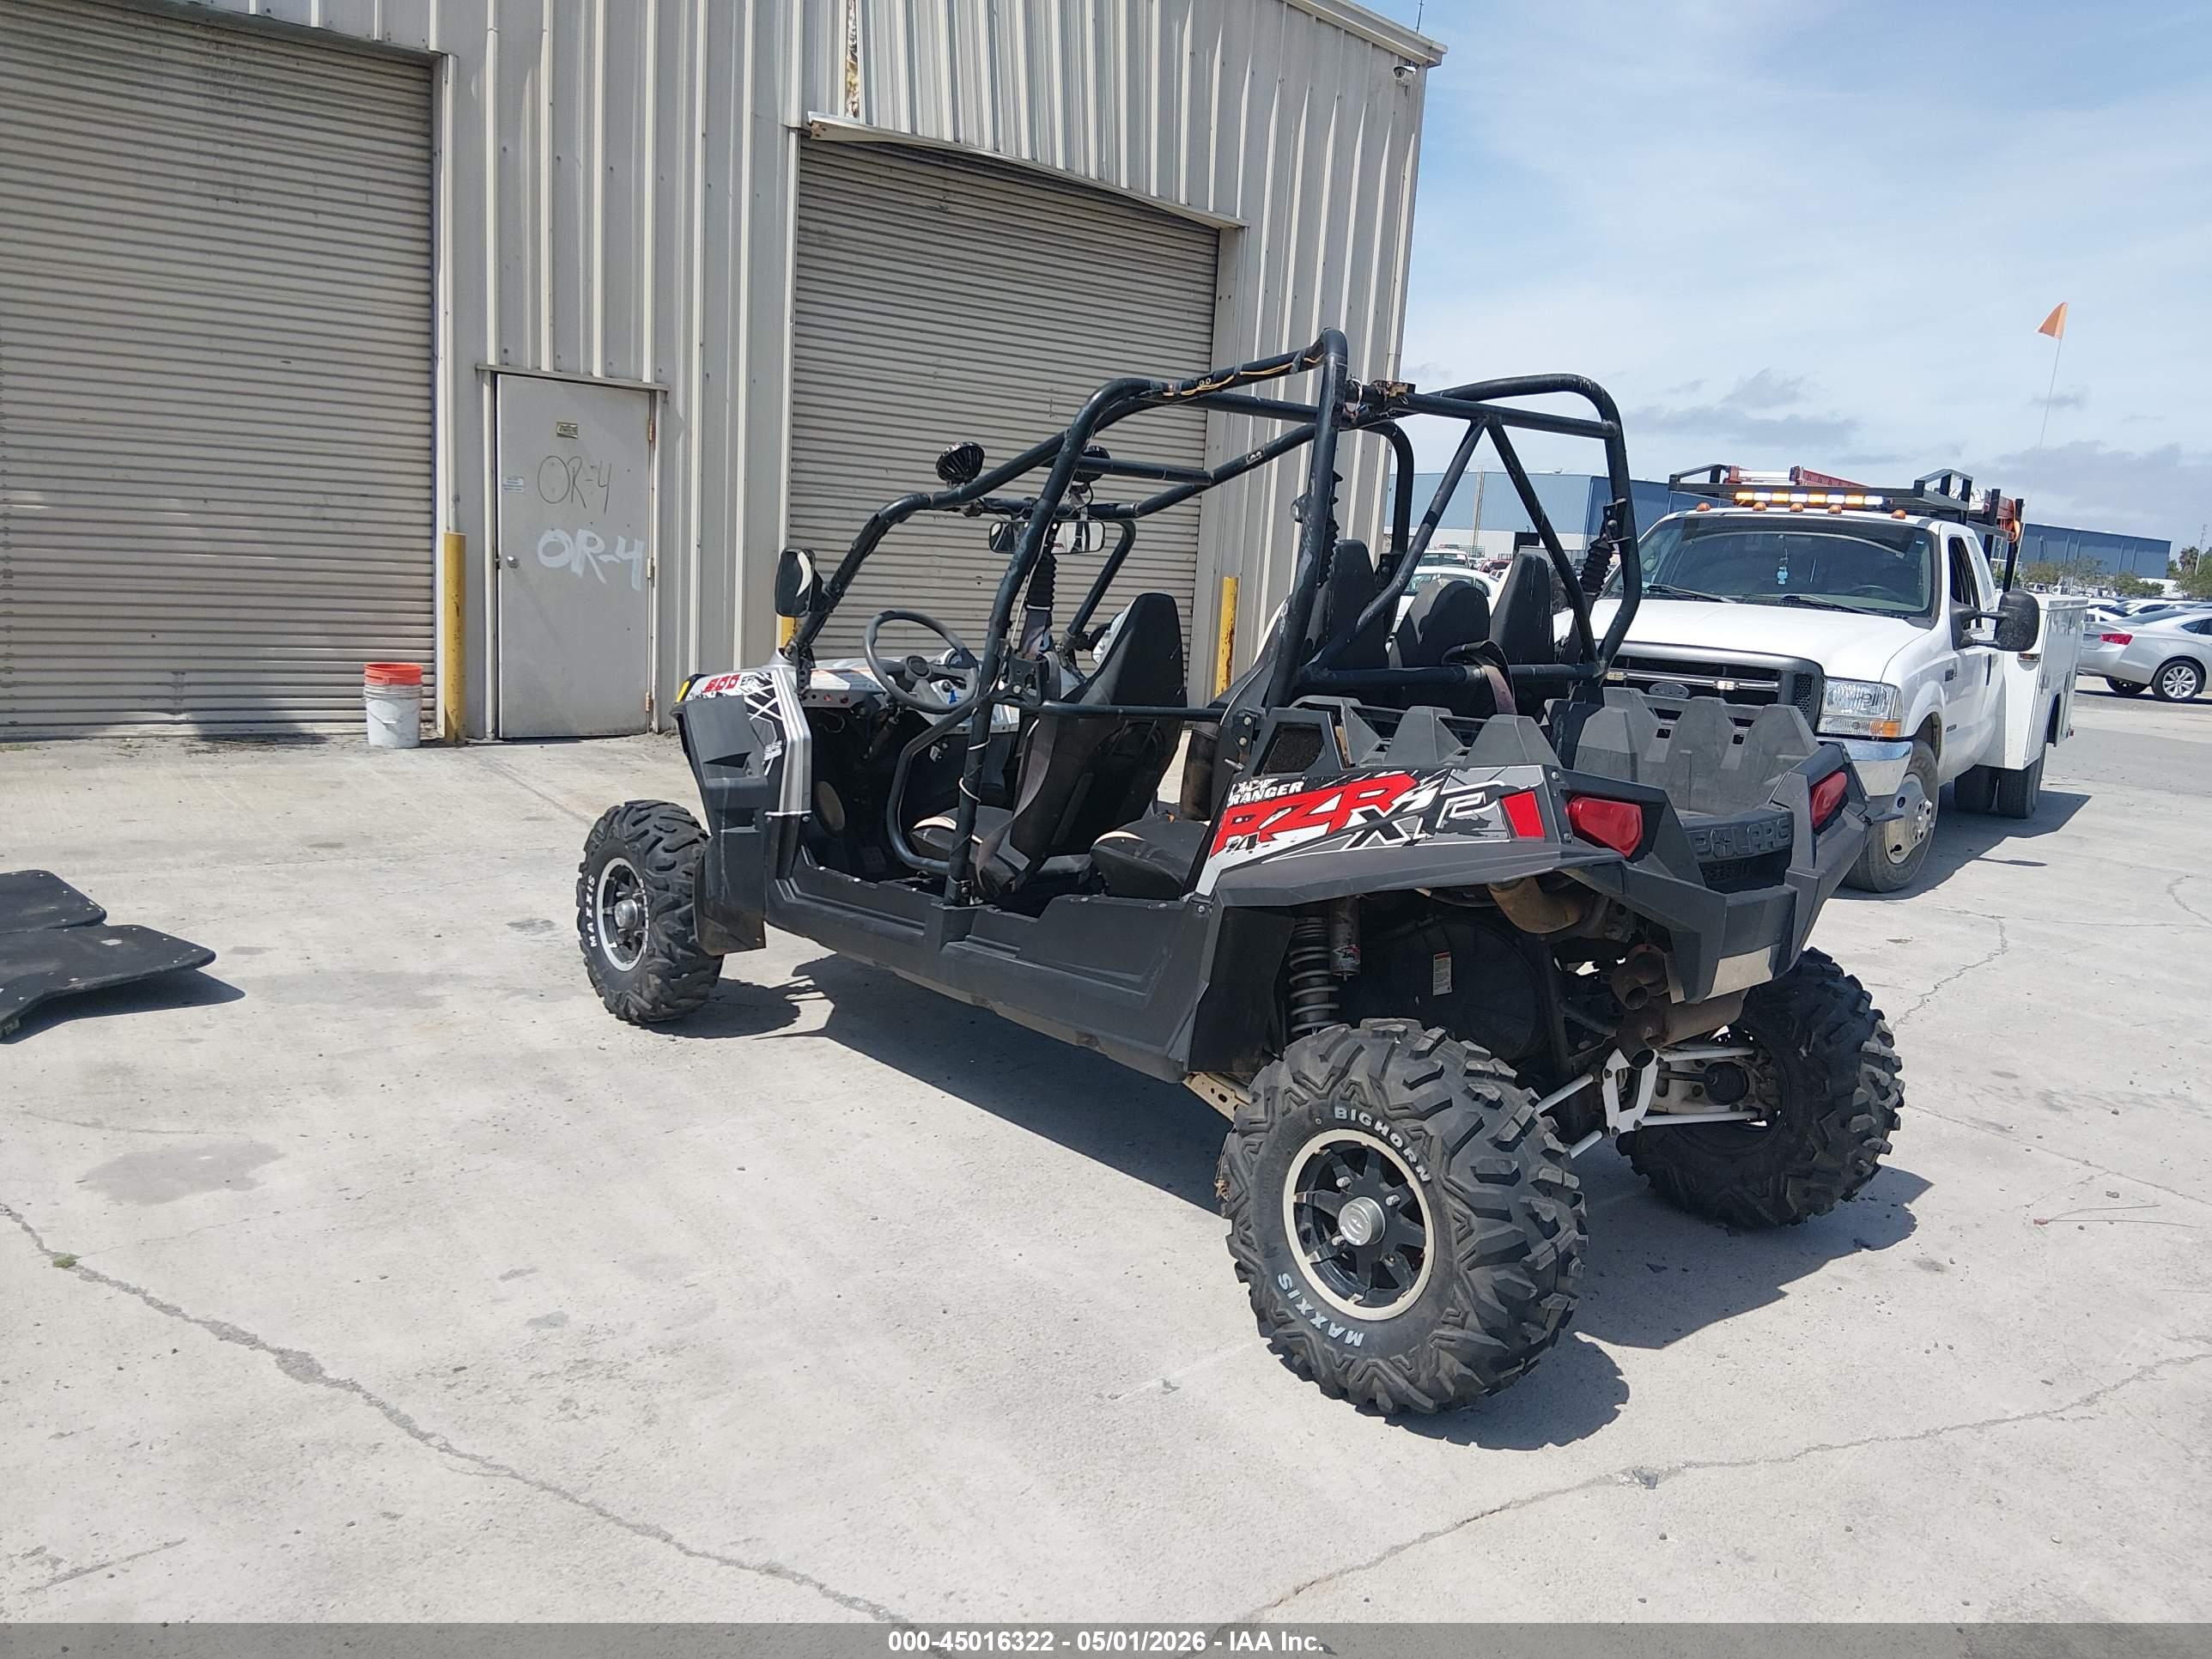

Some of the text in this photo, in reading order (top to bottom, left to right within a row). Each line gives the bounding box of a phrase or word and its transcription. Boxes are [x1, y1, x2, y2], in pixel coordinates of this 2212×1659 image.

[538, 455, 611, 515] OR-4
[538, 528, 644, 592] OR-4
[1211, 773, 1417, 856] RZR
[1226, 781, 1304, 808] RANGER
[1687, 817, 1792, 859] POLARIS
[586, 874, 596, 947] MAXXIS
[1334, 1106, 1432, 1182] BIGHORN
[1278, 1273, 1366, 1347] MAXXIS
